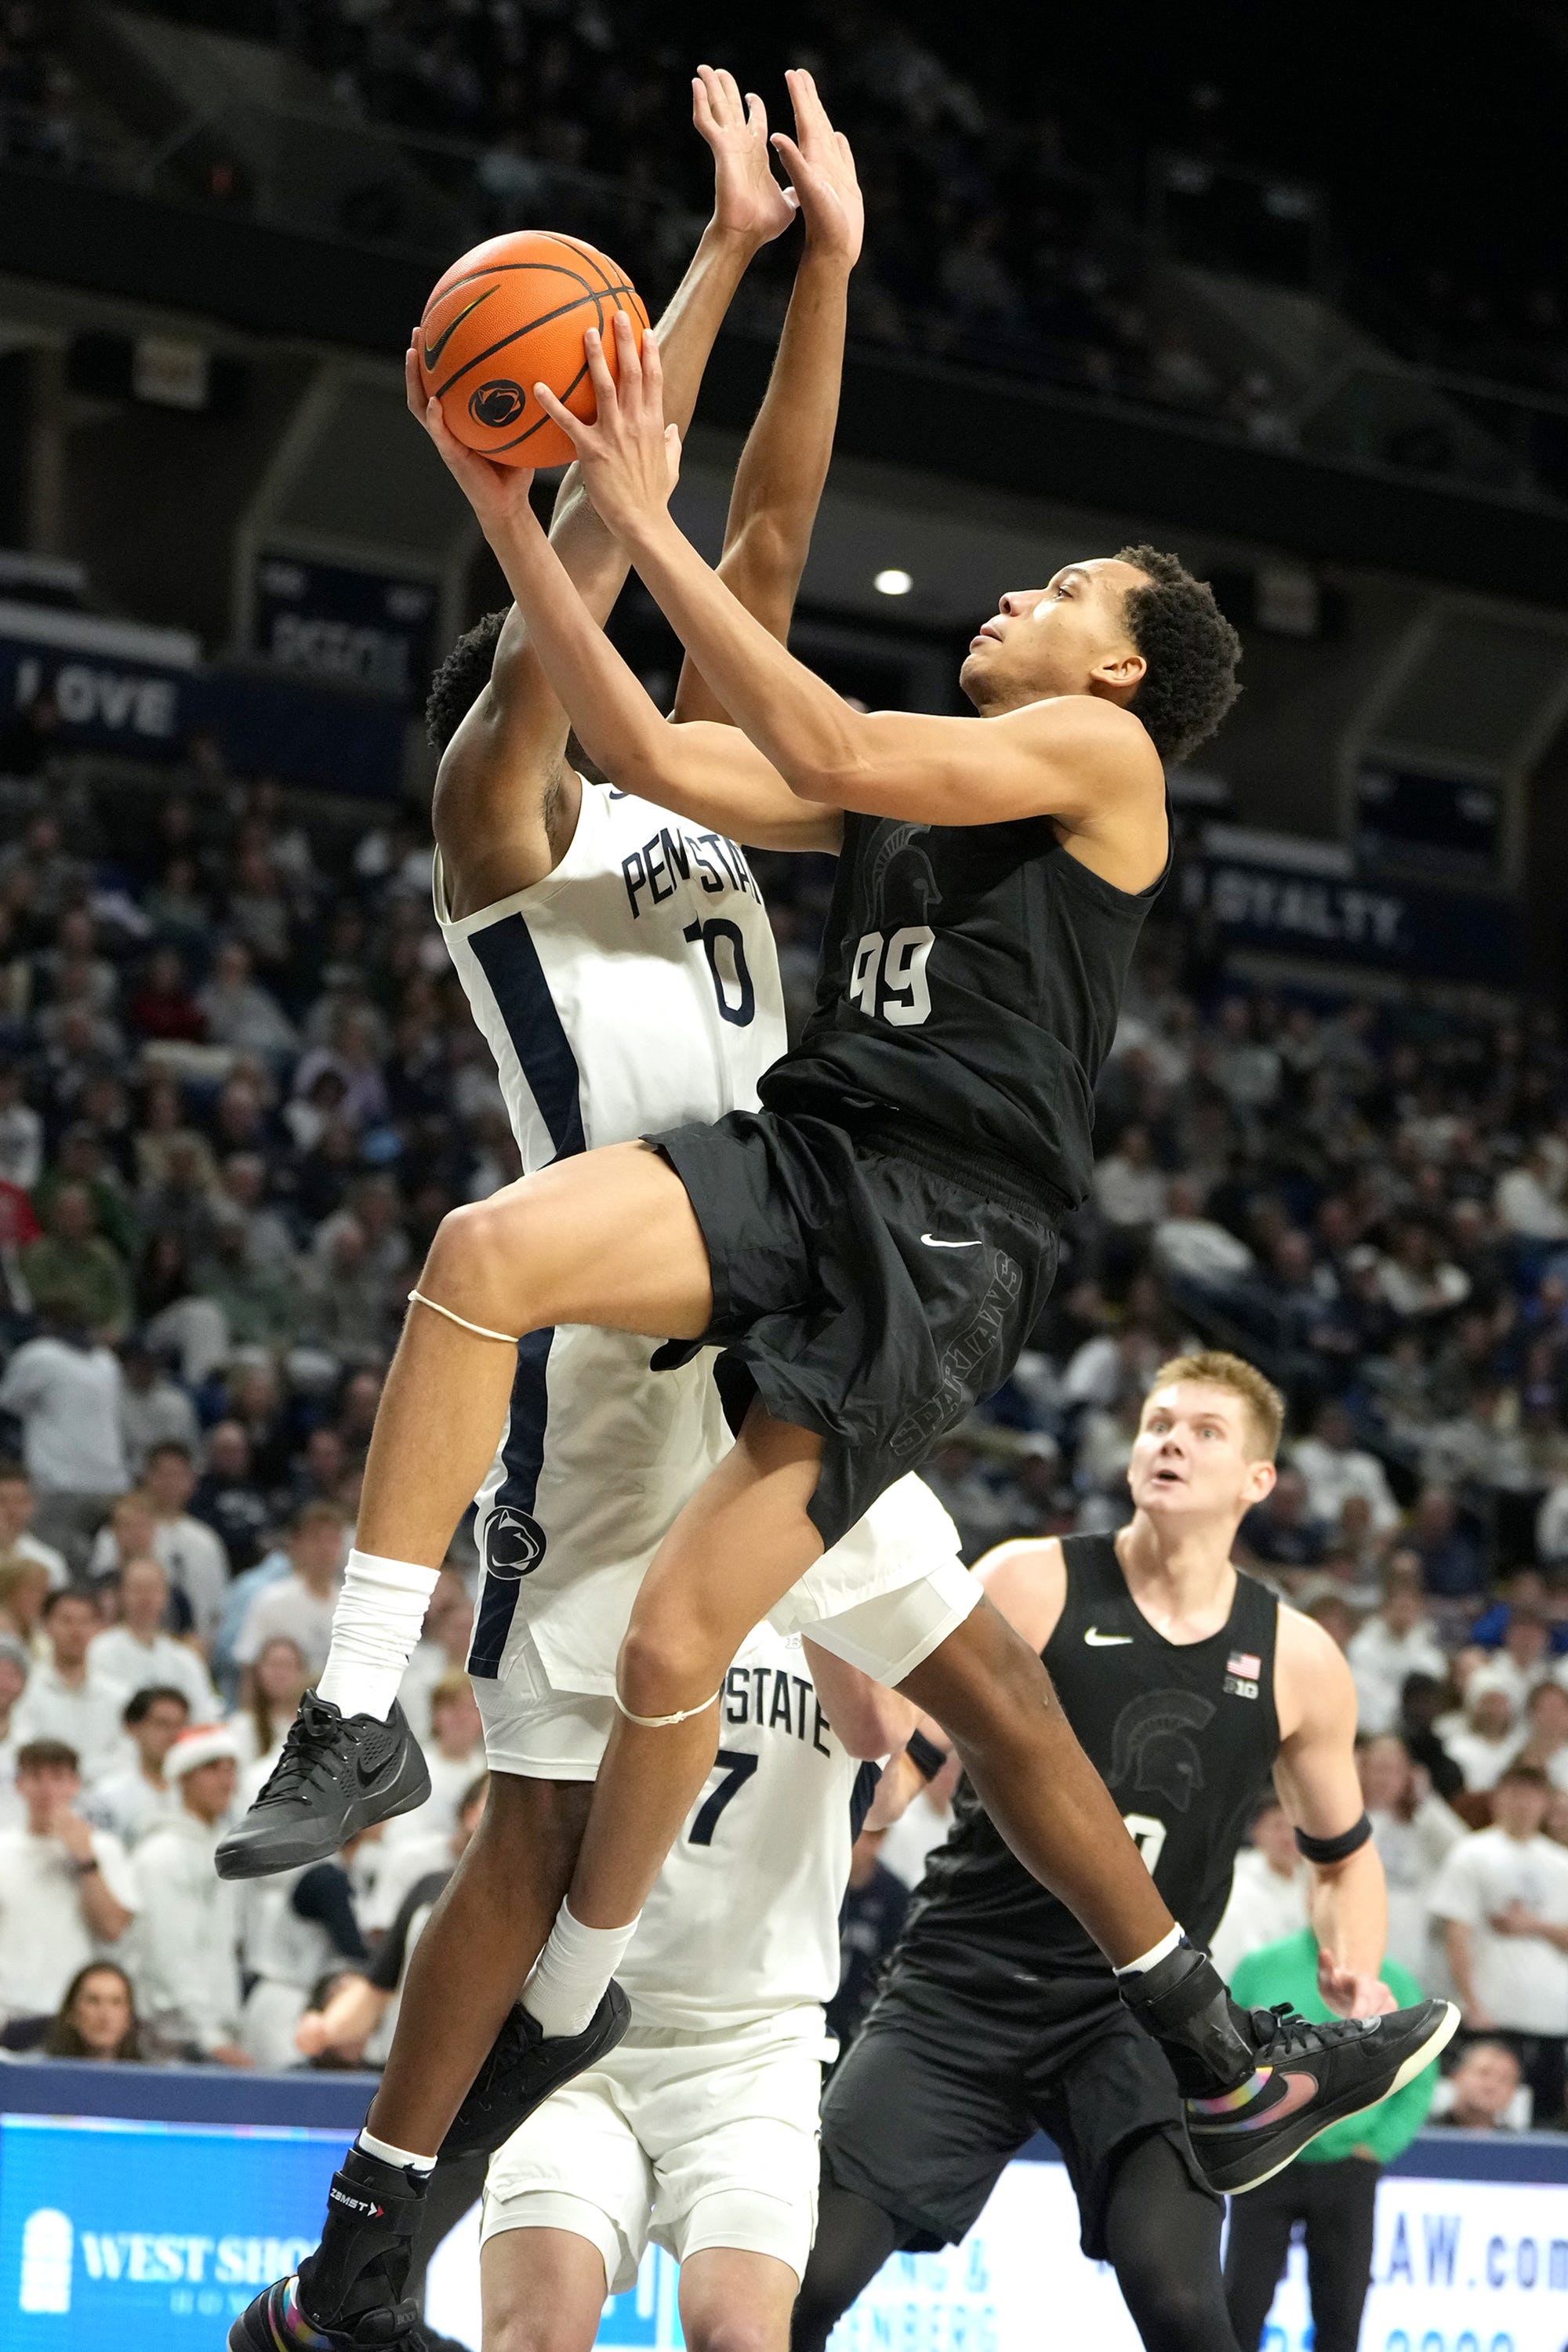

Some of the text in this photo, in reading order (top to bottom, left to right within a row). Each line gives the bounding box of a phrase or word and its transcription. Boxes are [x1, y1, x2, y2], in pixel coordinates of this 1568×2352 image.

[850, 926, 935, 1026] 99
[889, 1250, 1023, 1457] SPARTANS
[726, 1667, 831, 1759] STATE
[688, 1750, 758, 1846] 7
[81, 2232, 215, 2282] WEST
[1377, 2212, 1568, 2292] AW.com
